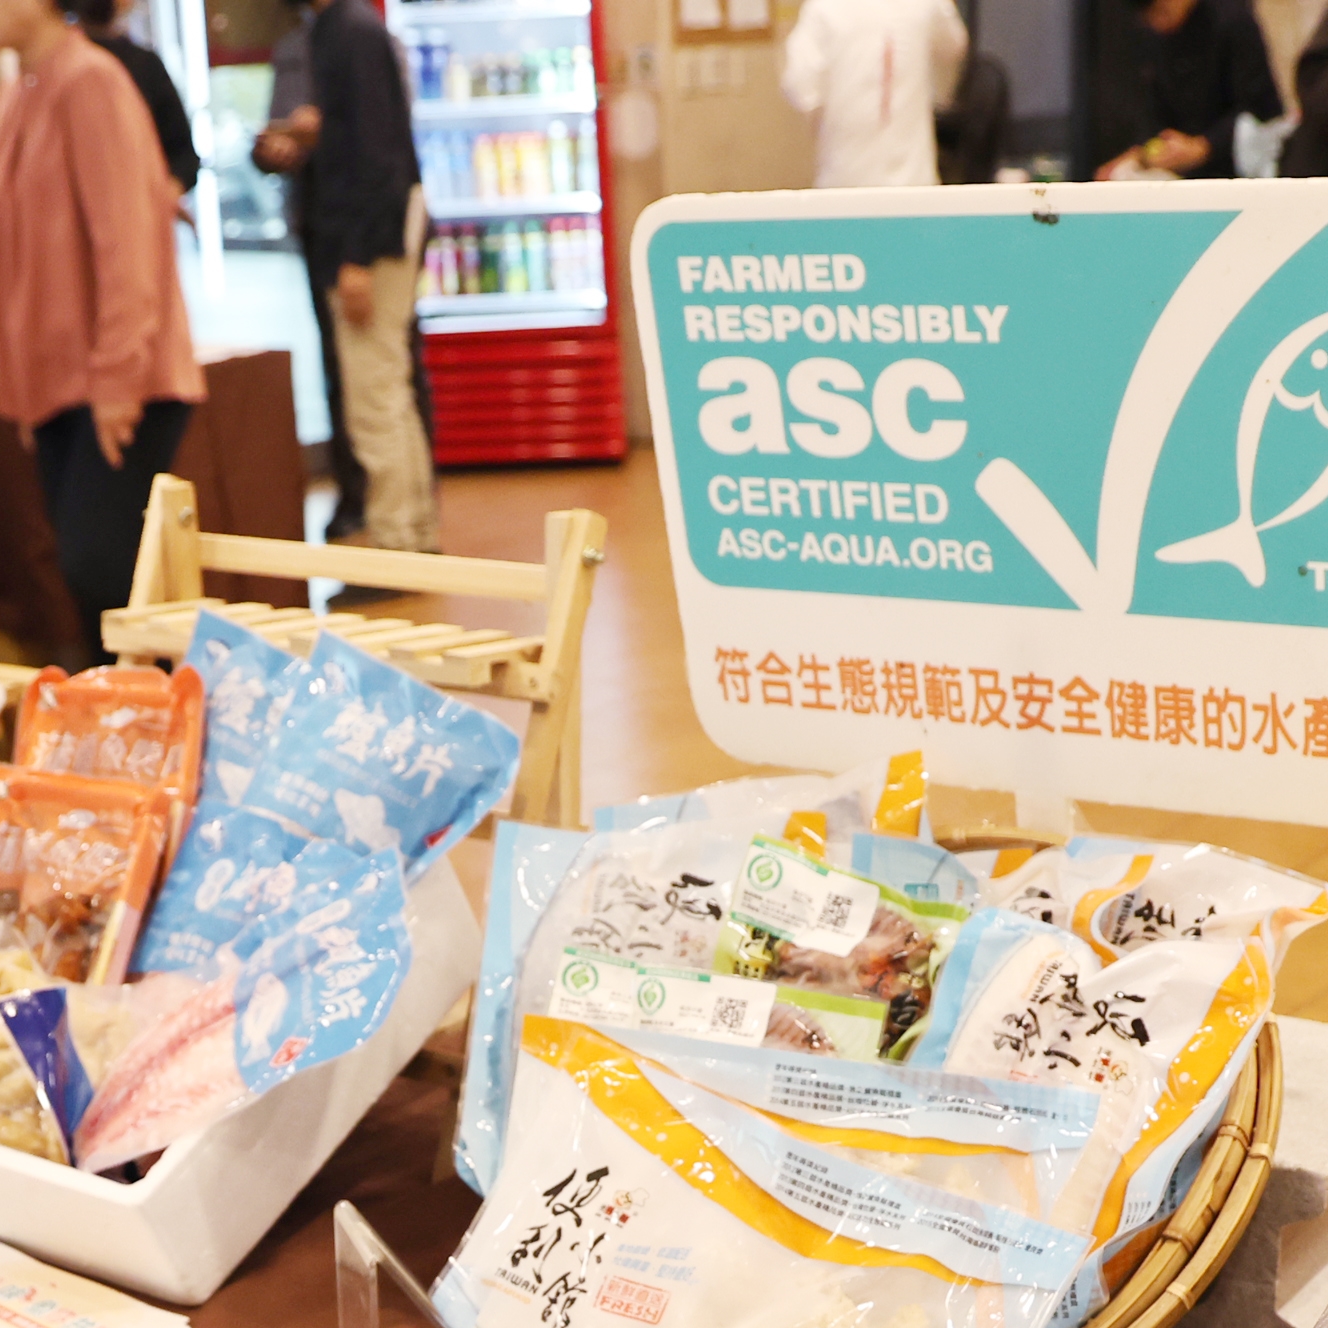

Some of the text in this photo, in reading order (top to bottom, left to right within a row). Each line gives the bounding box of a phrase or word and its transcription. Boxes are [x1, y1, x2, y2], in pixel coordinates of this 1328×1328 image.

[678, 254, 867, 292] FARMED
[683, 304, 1010, 344] RESPONSIBLY
[697, 355, 968, 461] asc
[707, 475, 949, 524] CERTIFIED
[716, 529, 995, 574] ASC-AQUA.ORG
[495, 1267, 540, 1296] TAIWAN
[599, 1296, 659, 1322] FRESH
